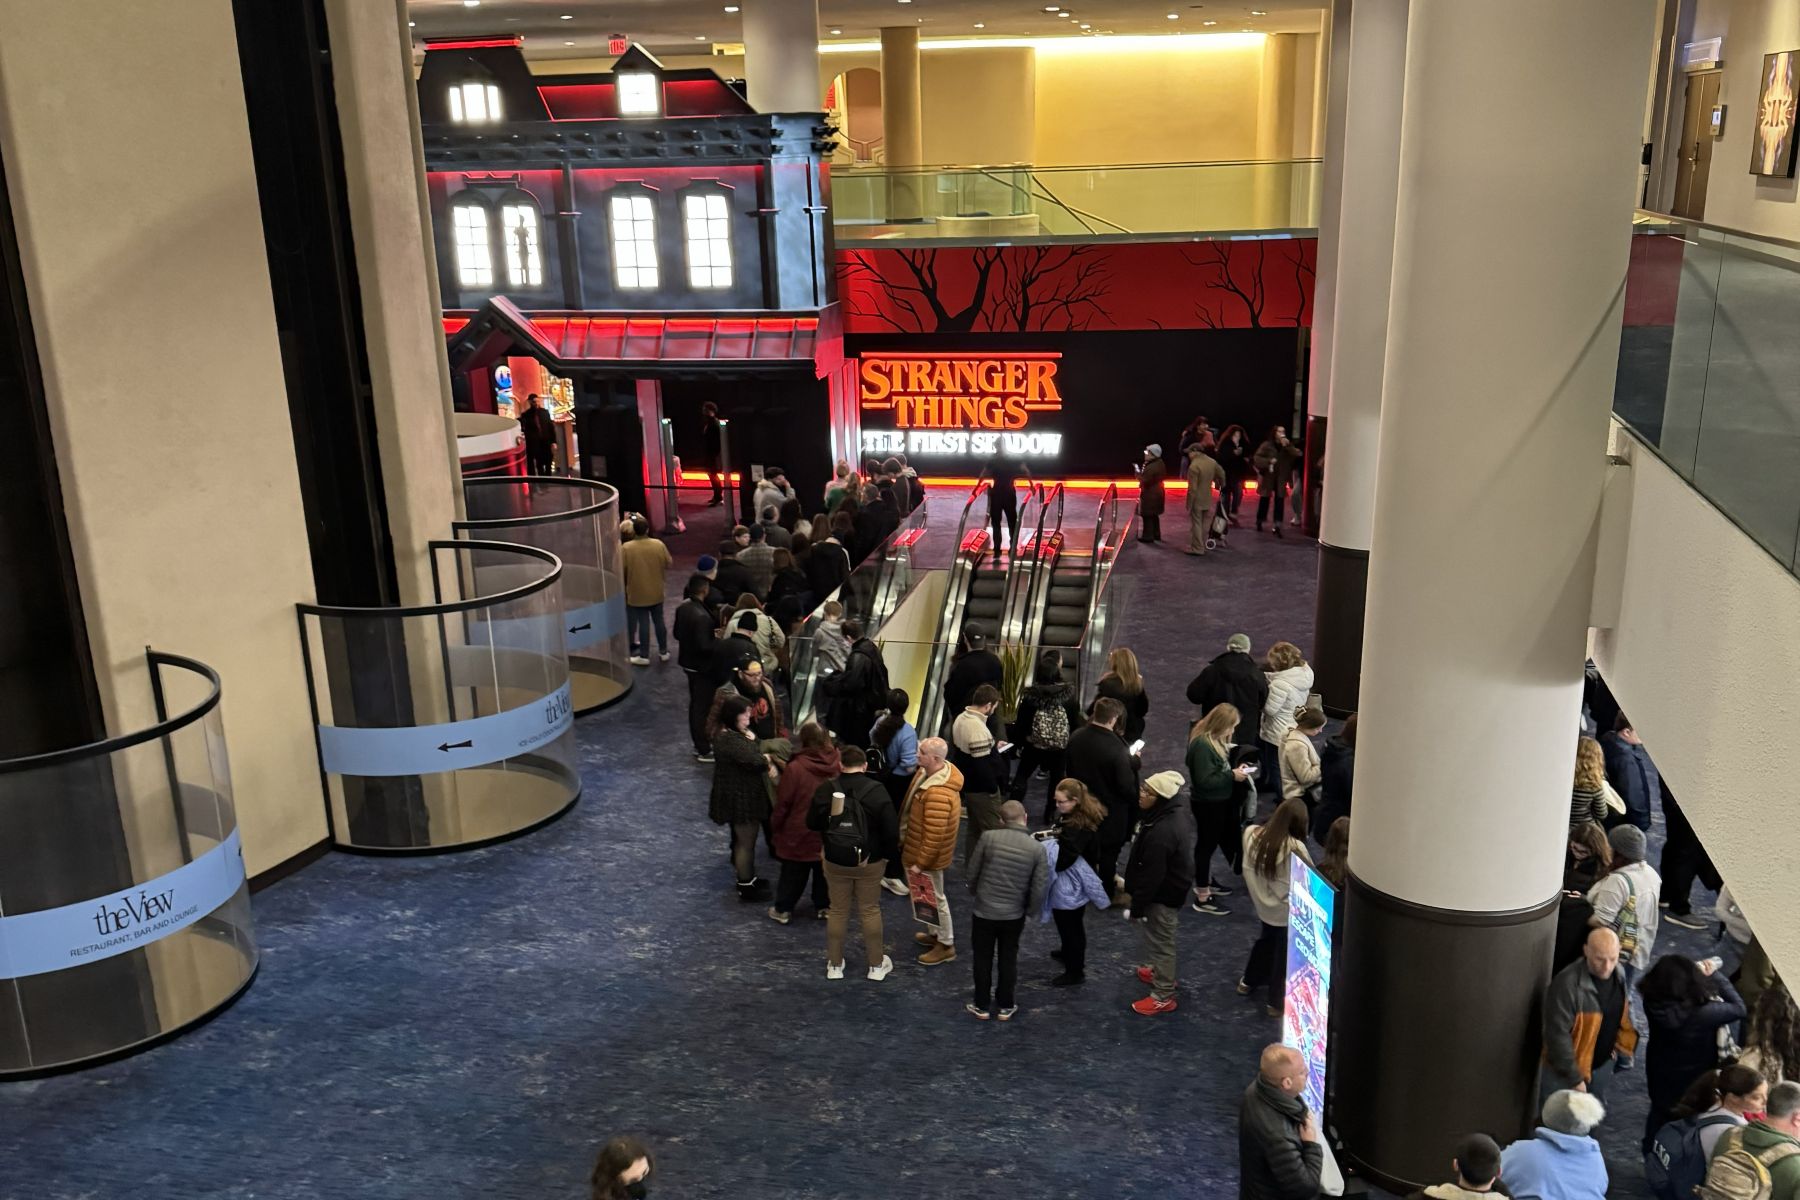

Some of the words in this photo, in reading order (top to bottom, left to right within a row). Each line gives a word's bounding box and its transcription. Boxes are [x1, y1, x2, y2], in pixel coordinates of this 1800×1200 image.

[861, 358, 1062, 402] STRANGER
[891, 396, 1028, 429] THINGS
[862, 430, 905, 452] THE
[909, 431, 970, 453] FIRST
[134, 926, 151, 938] BAR
[153, 920, 168, 930] AND
[170, 904, 198, 923] LOUNGE
